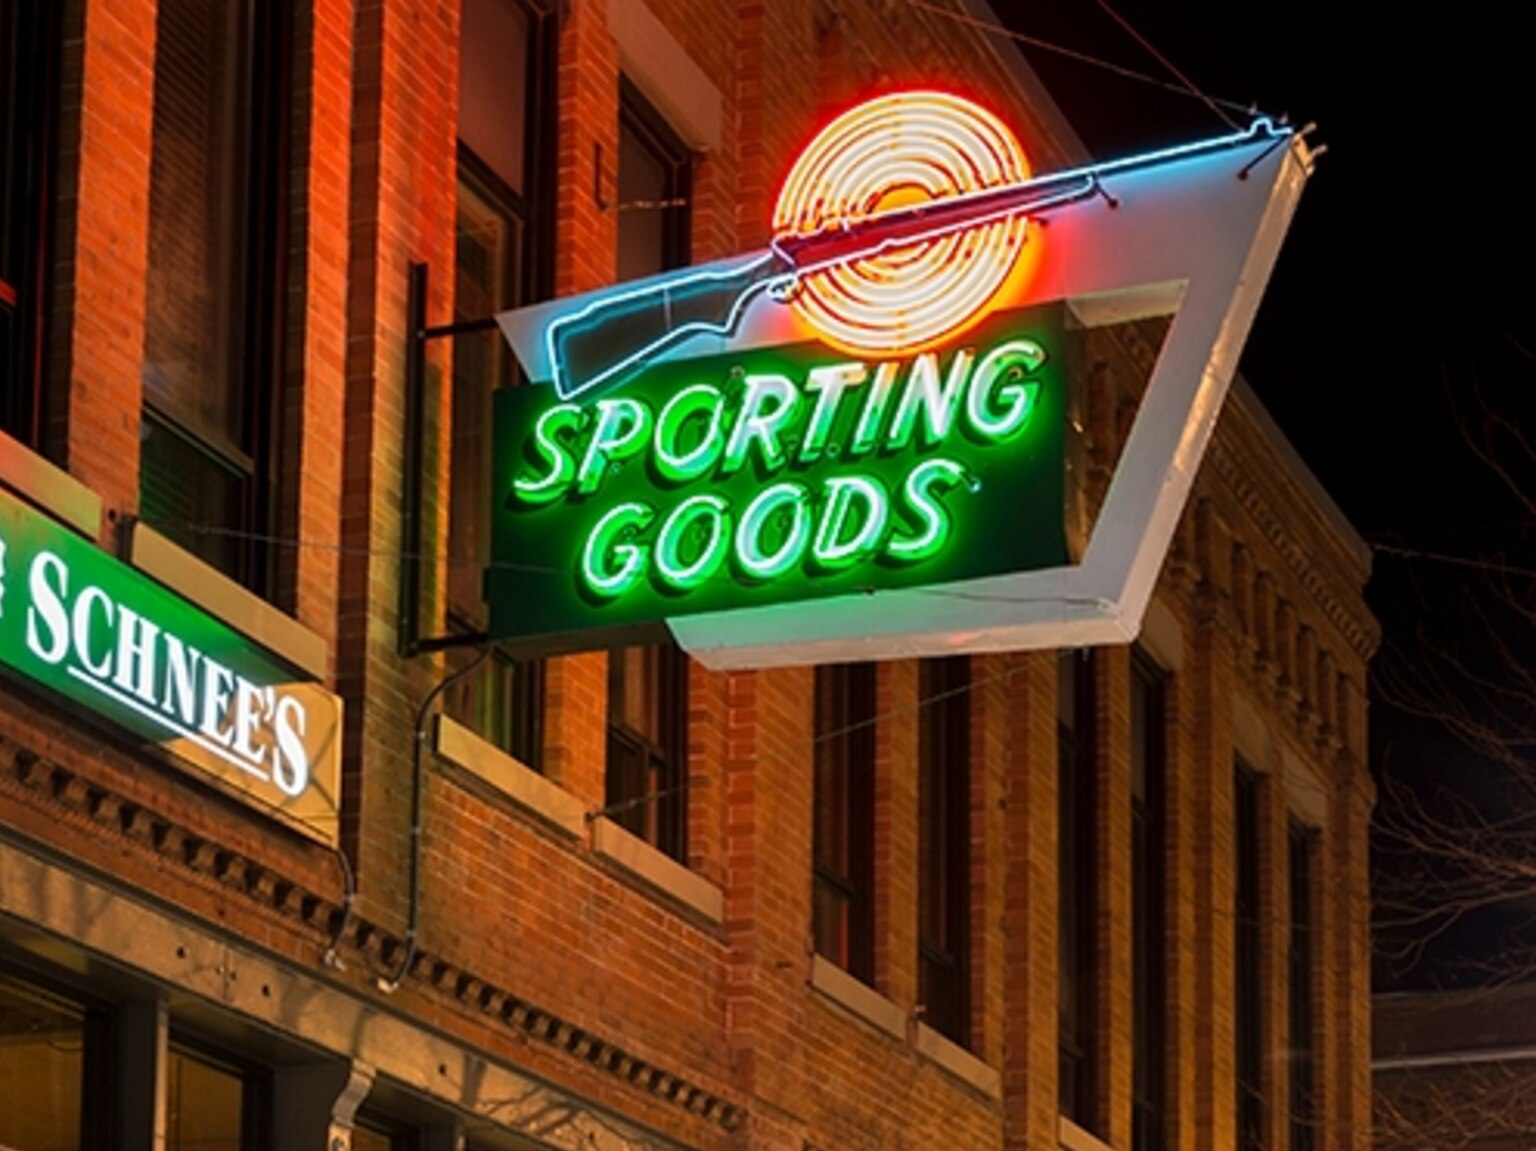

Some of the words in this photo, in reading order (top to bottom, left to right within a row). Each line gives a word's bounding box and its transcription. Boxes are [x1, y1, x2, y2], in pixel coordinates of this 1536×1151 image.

[513, 339, 1046, 503] SPORTING
[582, 457, 968, 595] GOODS
[27, 550, 309, 797] SCHNEE'S
